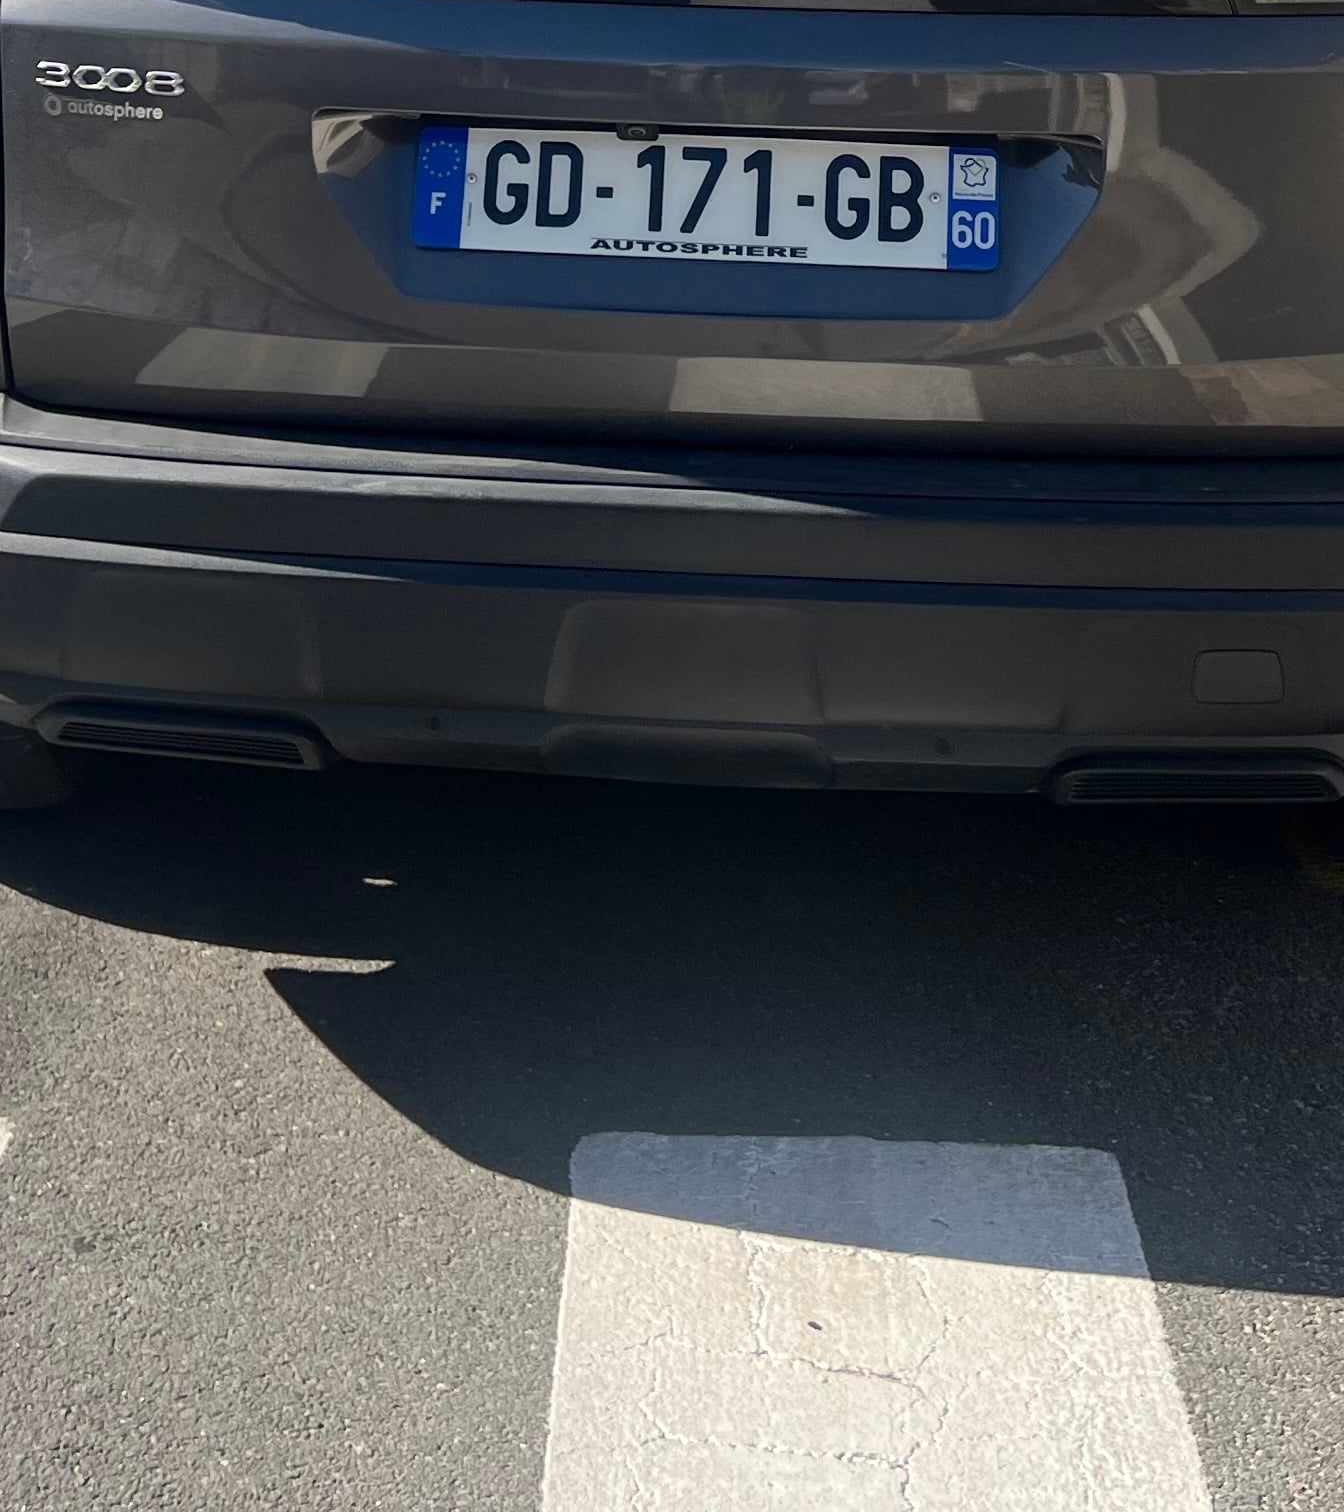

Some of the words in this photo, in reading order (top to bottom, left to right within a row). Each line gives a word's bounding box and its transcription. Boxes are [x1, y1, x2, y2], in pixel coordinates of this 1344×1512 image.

[35, 60, 186, 97] 3008
[67, 101, 164, 122] autosphere
[430, 192, 447, 215] F
[483, 139, 925, 243] GD-171-GB
[951, 210, 996, 250] 60
[590, 238, 809, 259] AUTOSPHERE
